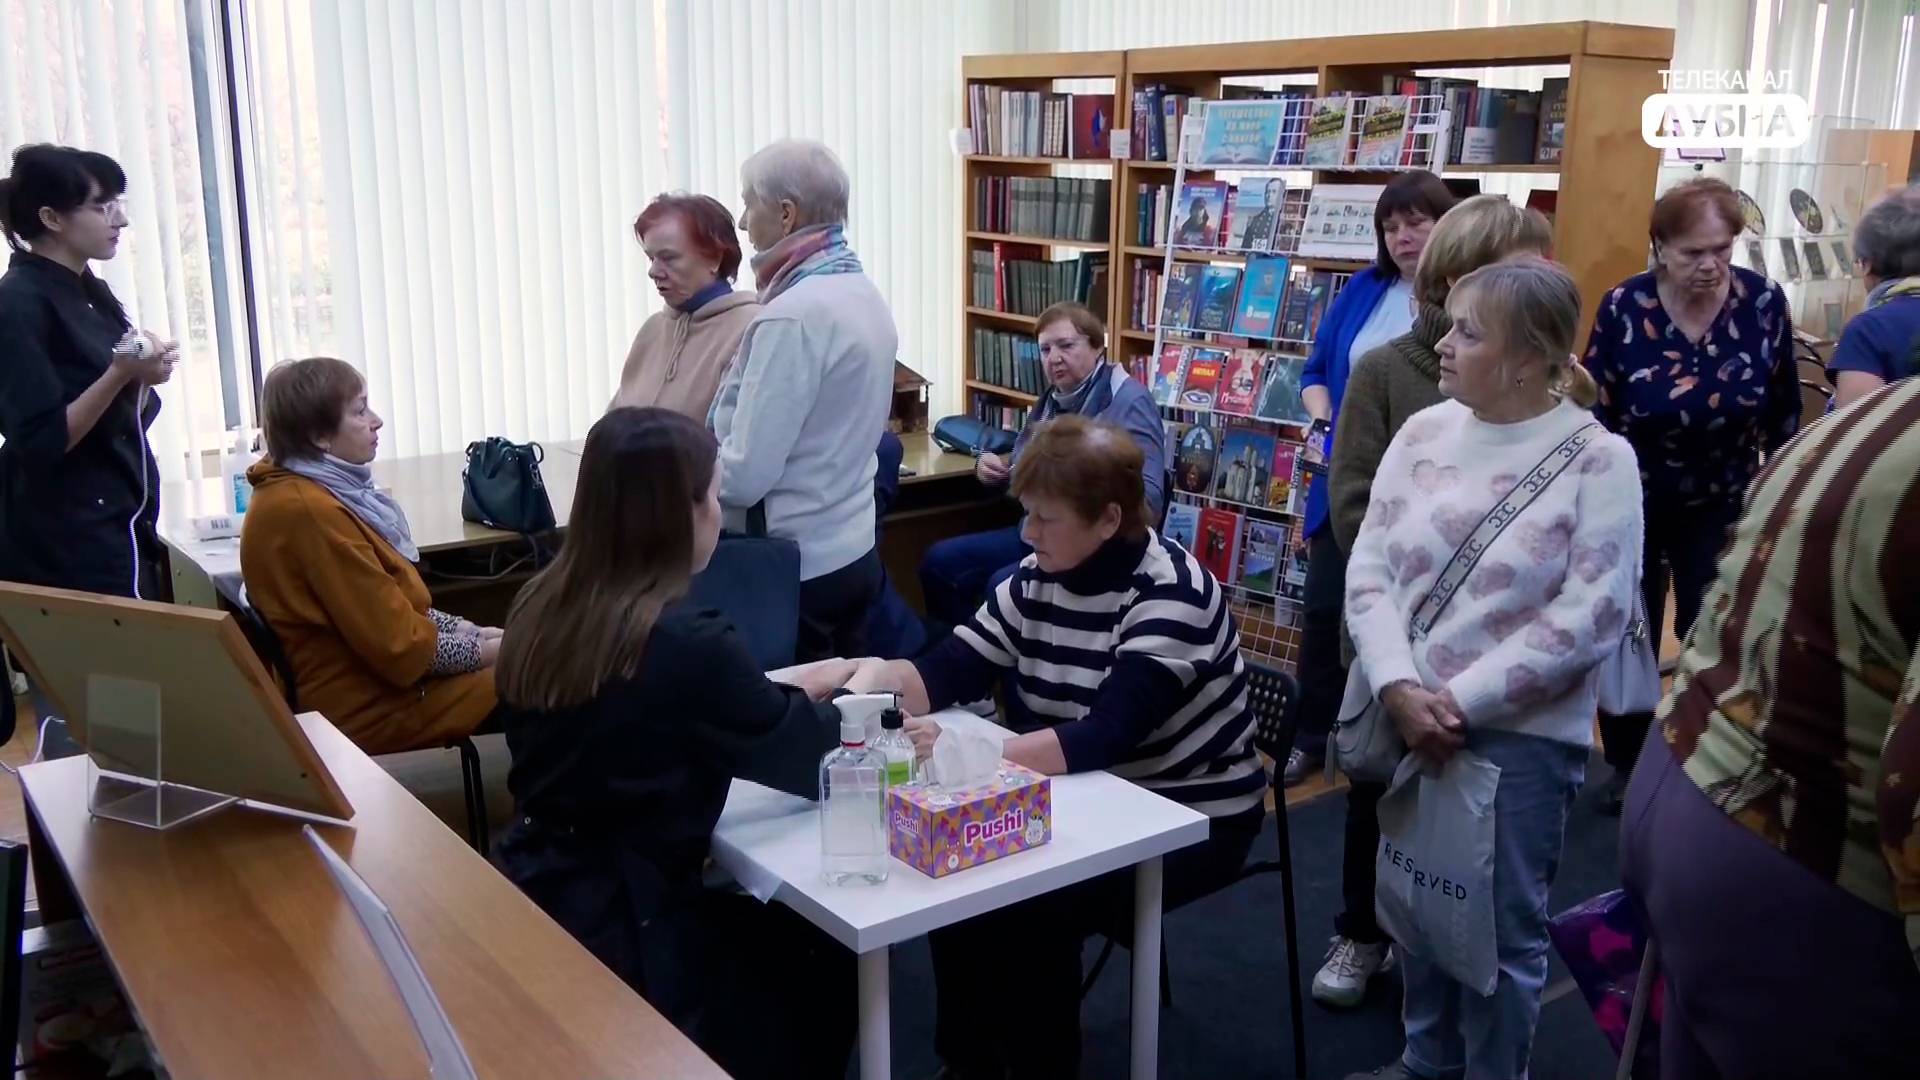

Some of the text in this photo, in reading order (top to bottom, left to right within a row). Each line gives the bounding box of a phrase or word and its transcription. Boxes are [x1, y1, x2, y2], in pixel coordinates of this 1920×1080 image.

[895, 811, 919, 834] Pushi
[965, 809, 1023, 846] Pushi
[1384, 842, 1467, 900] RESRVED
